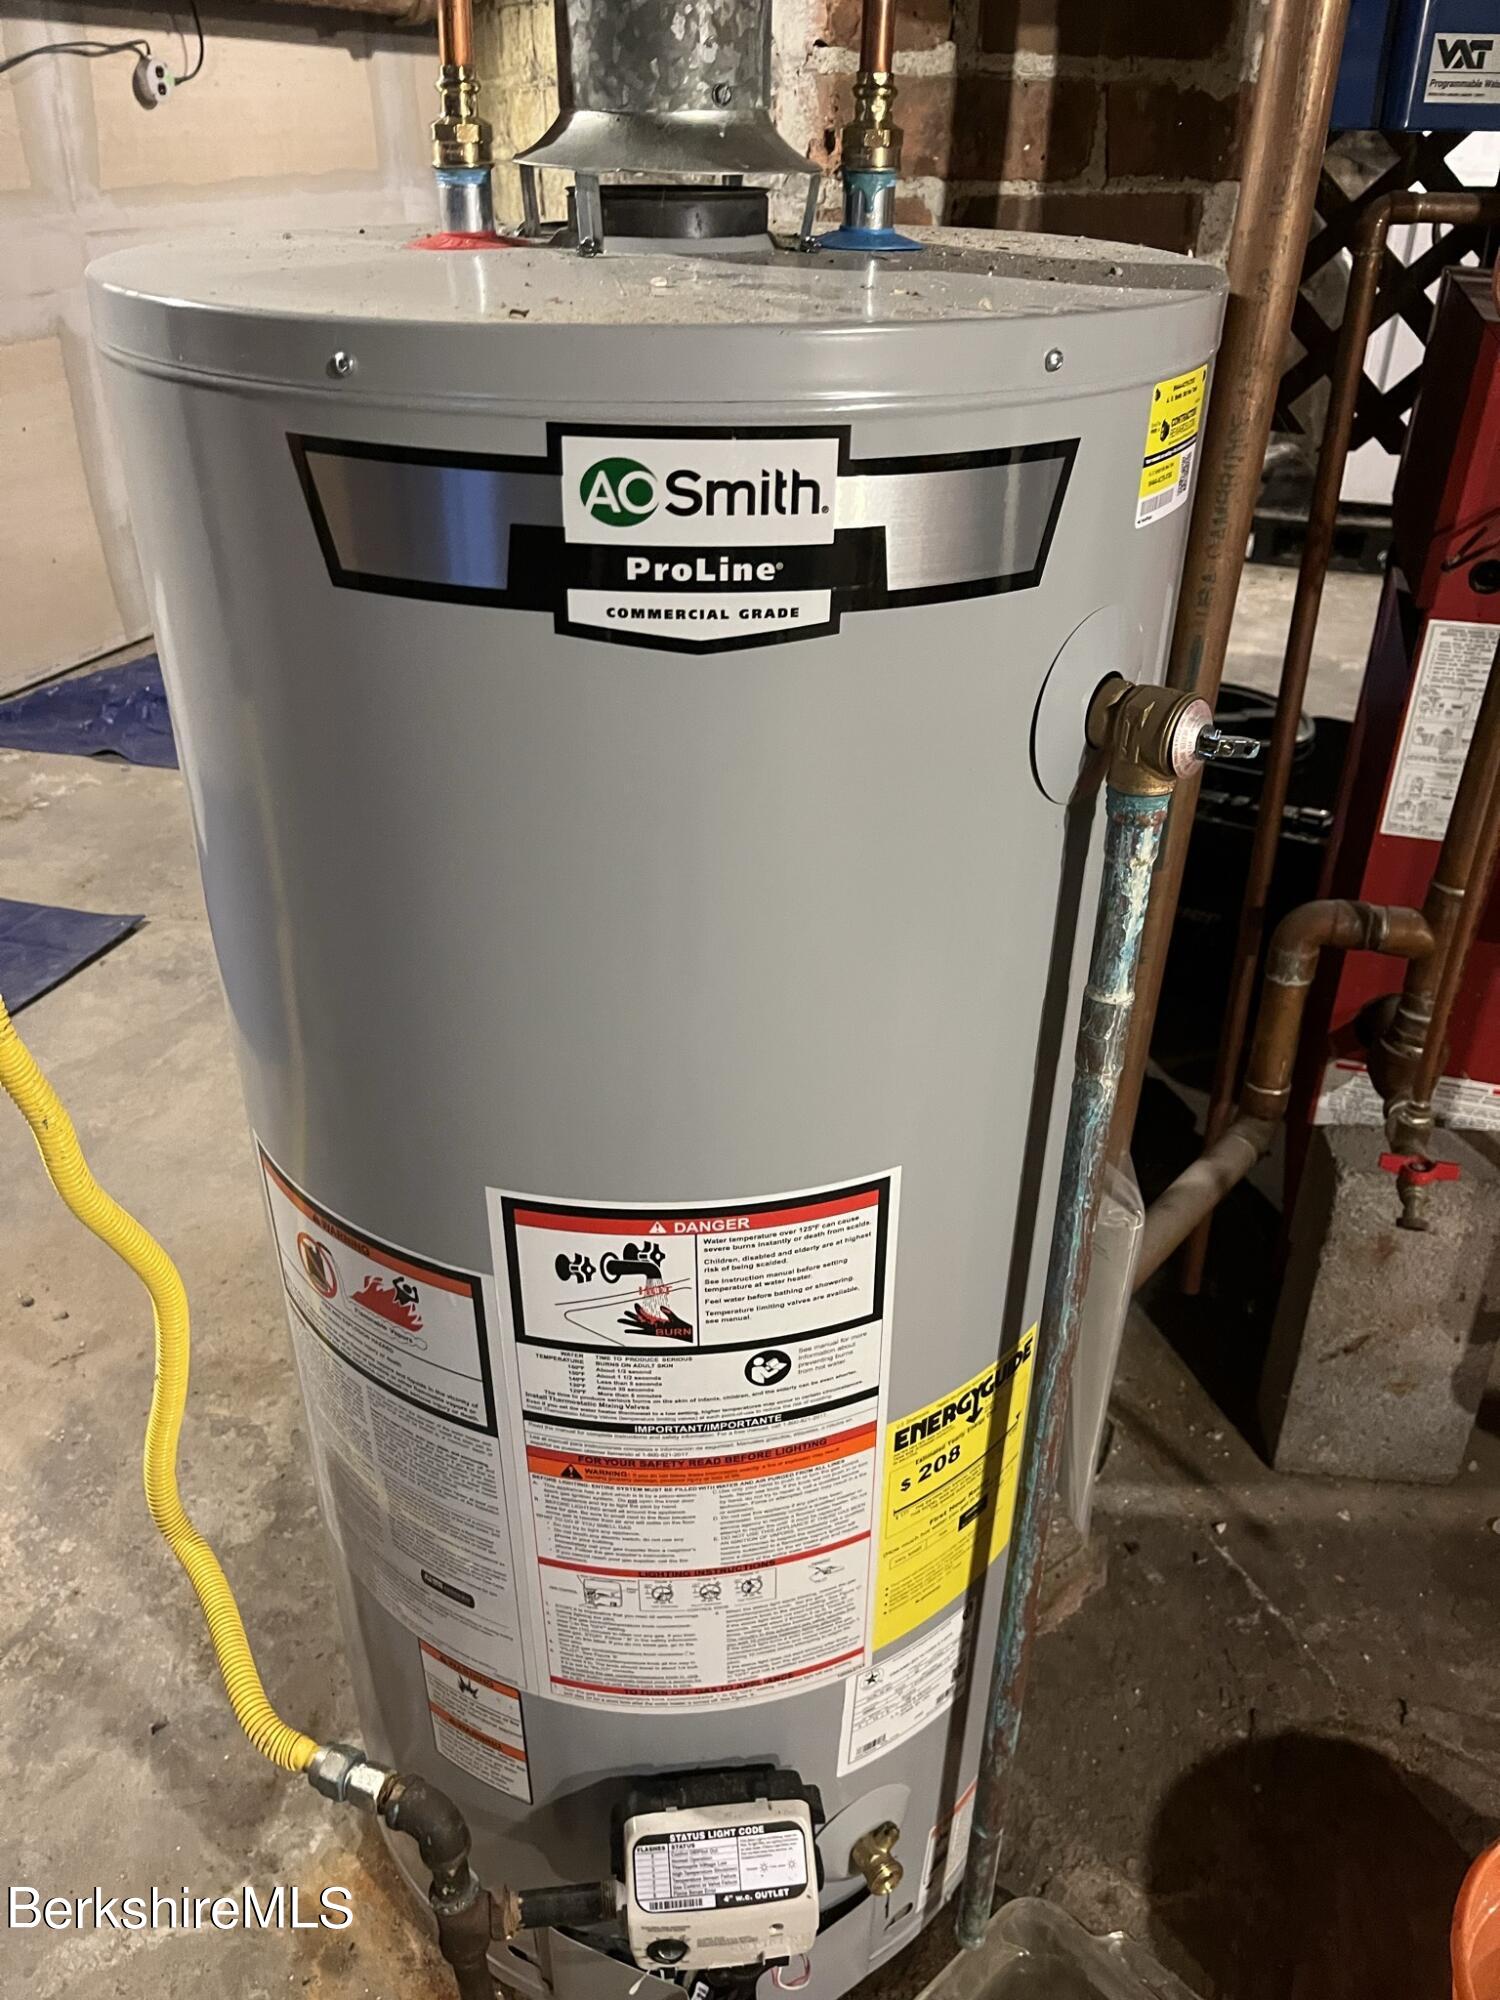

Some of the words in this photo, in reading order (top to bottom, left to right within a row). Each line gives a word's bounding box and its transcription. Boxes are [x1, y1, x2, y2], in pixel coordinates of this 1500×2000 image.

[665, 469, 820, 516] Smith
[626, 556, 776, 581] ProLine
[606, 608, 729, 620] COMMERCIAL
[739, 608, 799, 619] GRADE
[674, 1218, 750, 1234] DANGER
[729, 1232, 777, 1242] temperature
[838, 1216, 859, 1225] cause
[758, 1237, 791, 1247] instantly
[804, 1232, 825, 1240] death
[846, 1221, 872, 1230] scalds.
[704, 1257, 740, 1265] Children,
[742, 1253, 775, 1261] disabled
[794, 1244, 819, 1254] elderly
[845, 1232, 872, 1243] highest
[722, 1274, 764, 1283] instruction
[767, 1269, 794, 1278] manual
[797, 1264, 820, 1273] before
[823, 1258, 848, 1267] setting
[732, 1263, 753, 1271] being
[756, 1258, 787, 1267] scalded.
[704, 1283, 752, 1293] temperature
[764, 1278, 785, 1286] water
[724, 1295, 745, 1303] water
[748, 1291, 772, 1300] before
[774, 1287, 802, 1297] bathing
[815, 1275, 854, 1288] showering.
[706, 1307, 754, 1317] Temperature
[756, 1301, 785, 1311] limiting
[787, 1298, 810, 1306] valves
[655, 1326, 691, 1337] BURN
[536, 1353, 584, 1364] TEMPERATURE
[526, 1392, 547, 1400] Install
[549, 1395, 597, 1408] Thermostatic
[599, 1402, 624, 1410] Mixing
[634, 1413, 782, 1434] IMPORTANT/IMPORTANTE
[578, 1456, 602, 1464] FOR
[605, 1457, 635, 1467] YOUR
[639, 1459, 684, 1468] SAFETY
[724, 1448, 771, 1463] BEFORE
[776, 1438, 827, 1456] LIGHTING
[918, 1444, 961, 1484] 208
[670, 1833, 705, 1842] STATUS
[708, 1829, 736, 1839] LIGHT
[738, 1826, 764, 1836] CODE
[755, 1888, 790, 1899] OUTLET
